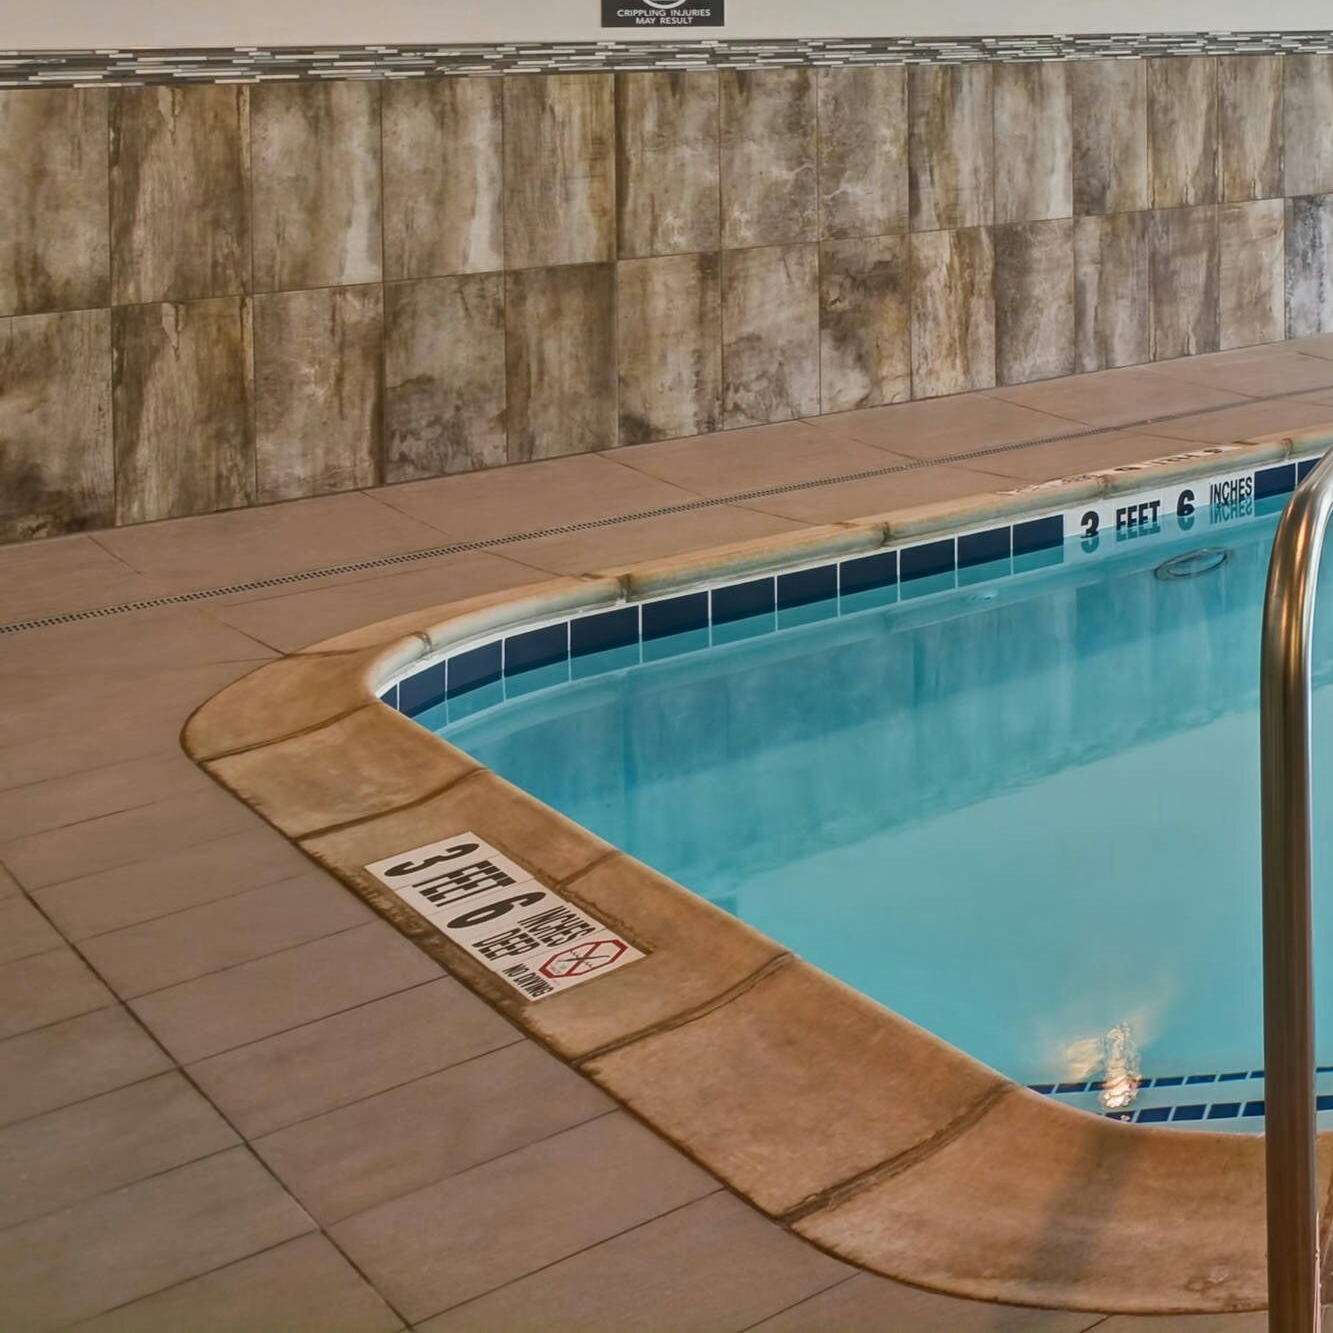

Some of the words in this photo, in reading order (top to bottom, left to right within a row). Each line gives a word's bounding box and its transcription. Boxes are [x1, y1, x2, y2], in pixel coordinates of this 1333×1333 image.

[617, 9, 667, 17] CRIPPLING
[671, 9, 711, 17] INJURIES
[635, 17, 656, 25] MAY
[660, 17, 693, 25] RESULT
[1080, 510, 1100, 539] 3
[1116, 500, 1160, 530] FEET
[1176, 489, 1195, 517] 6
[1209, 476, 1253, 506] INCHES
[383, 842, 480, 878] 3
[411, 859, 518, 908] FEET
[446, 891, 547, 929] 6
[517, 905, 597, 947] INCHES
[472, 927, 540, 961] DEEP
[502, 962, 530, 979] NO
[513, 971, 554, 998] DIVING
